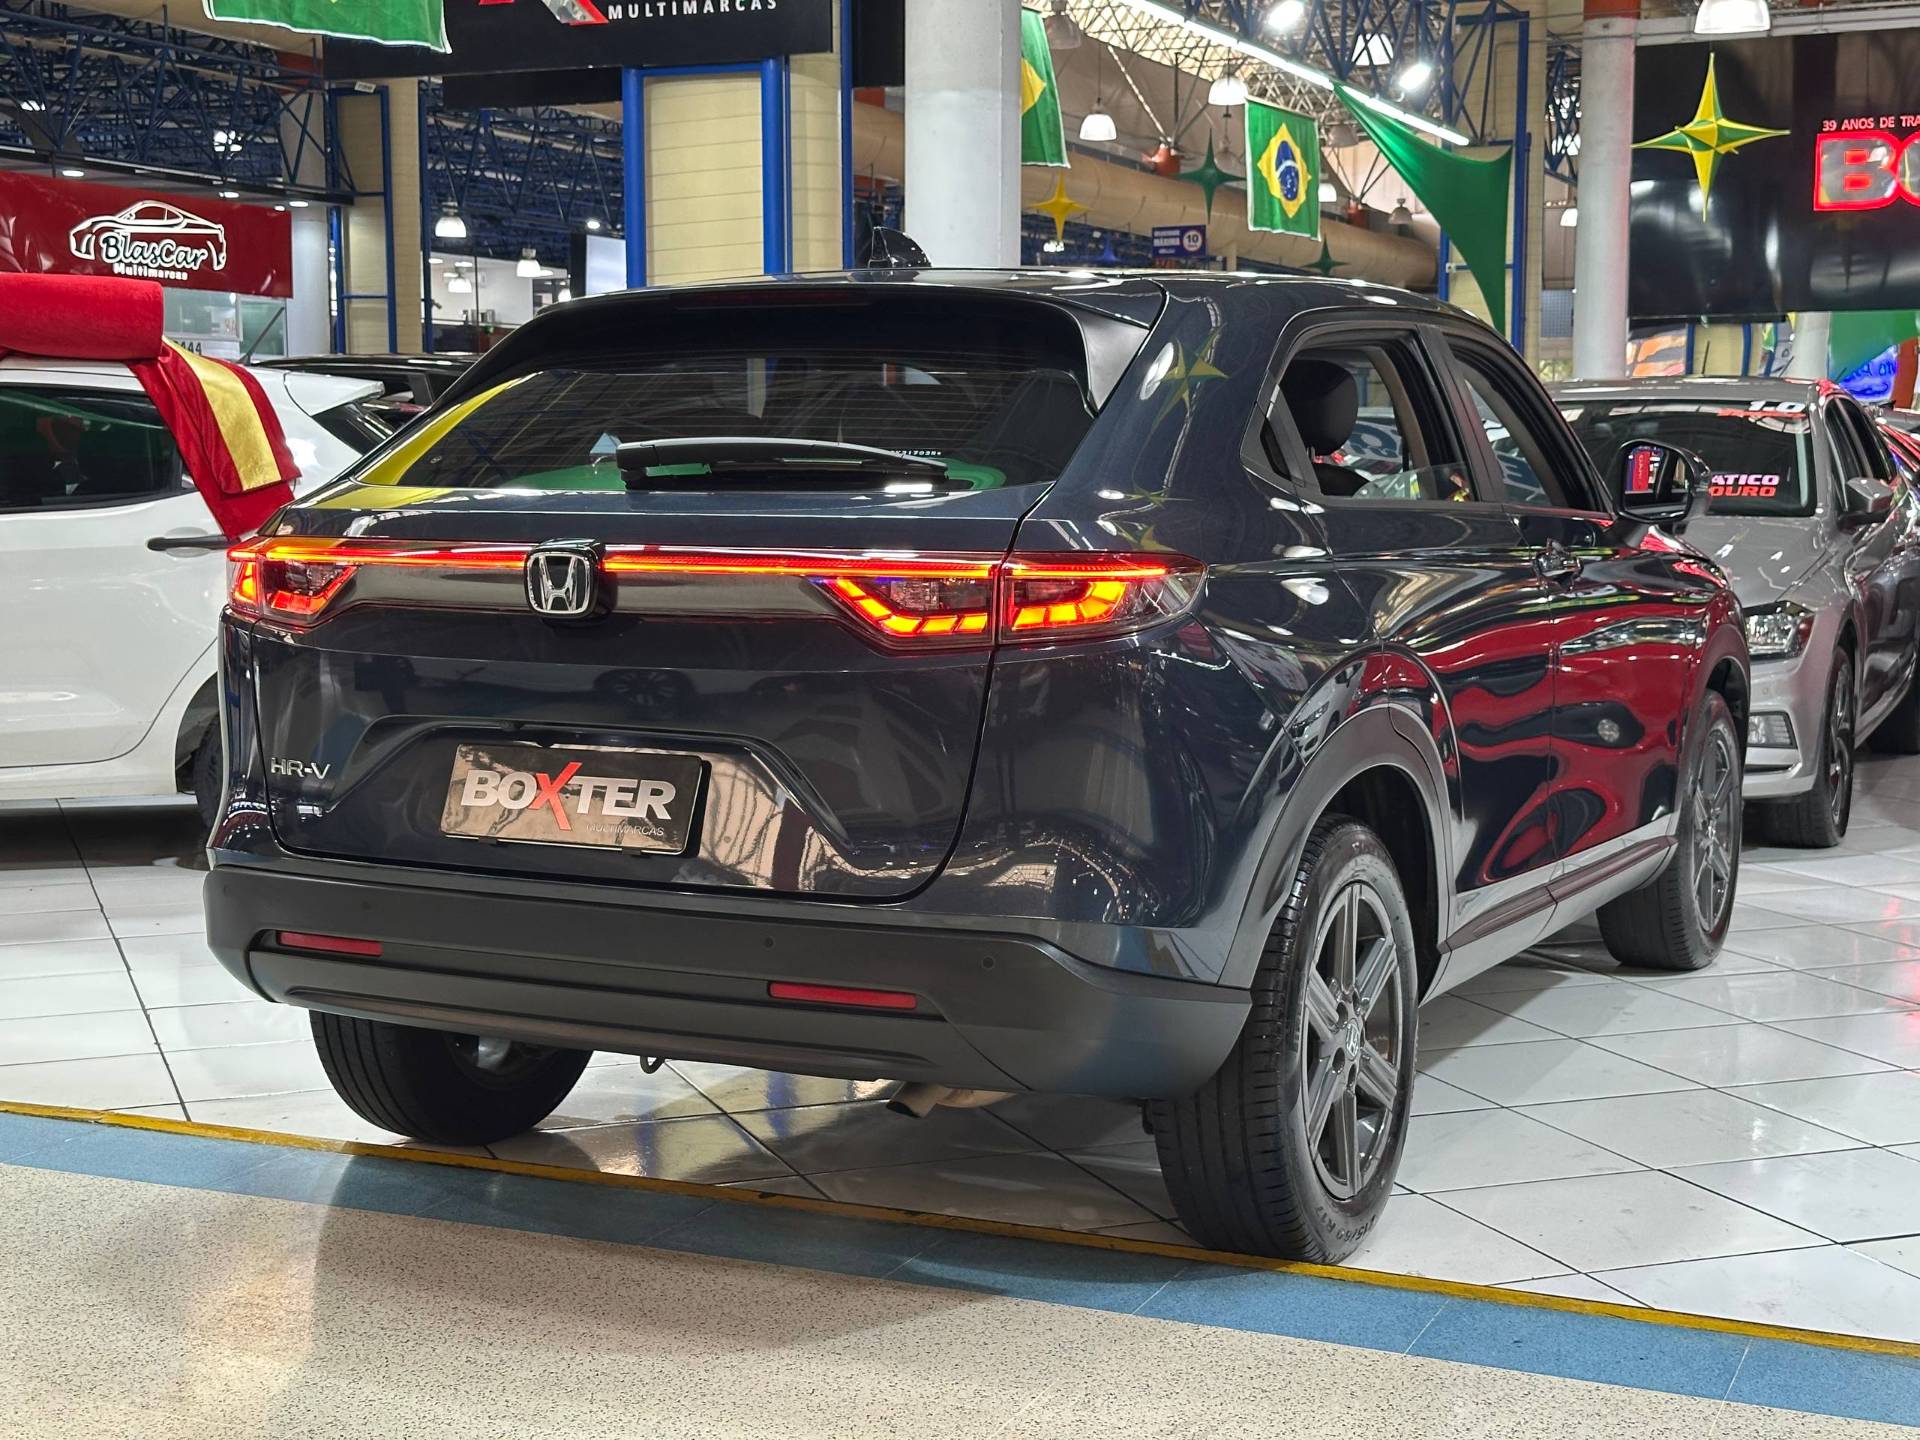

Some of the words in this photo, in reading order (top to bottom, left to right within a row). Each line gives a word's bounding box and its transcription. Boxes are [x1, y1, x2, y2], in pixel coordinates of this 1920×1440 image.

[608, 0, 777, 20] MULTIMARCAS
[1822, 119, 1837, 132] 39
[1841, 117, 1875, 131] ANOS
[1879, 116, 1895, 128] DE
[1186, 233, 1199, 244] 10
[101, 232, 208, 269] BlasCar
[1747, 401, 1806, 413] 1.0
[271, 757, 331, 779] HR-V
[461, 762, 676, 831] BOXTER
[586, 823, 664, 836] MULTIMARCAS
